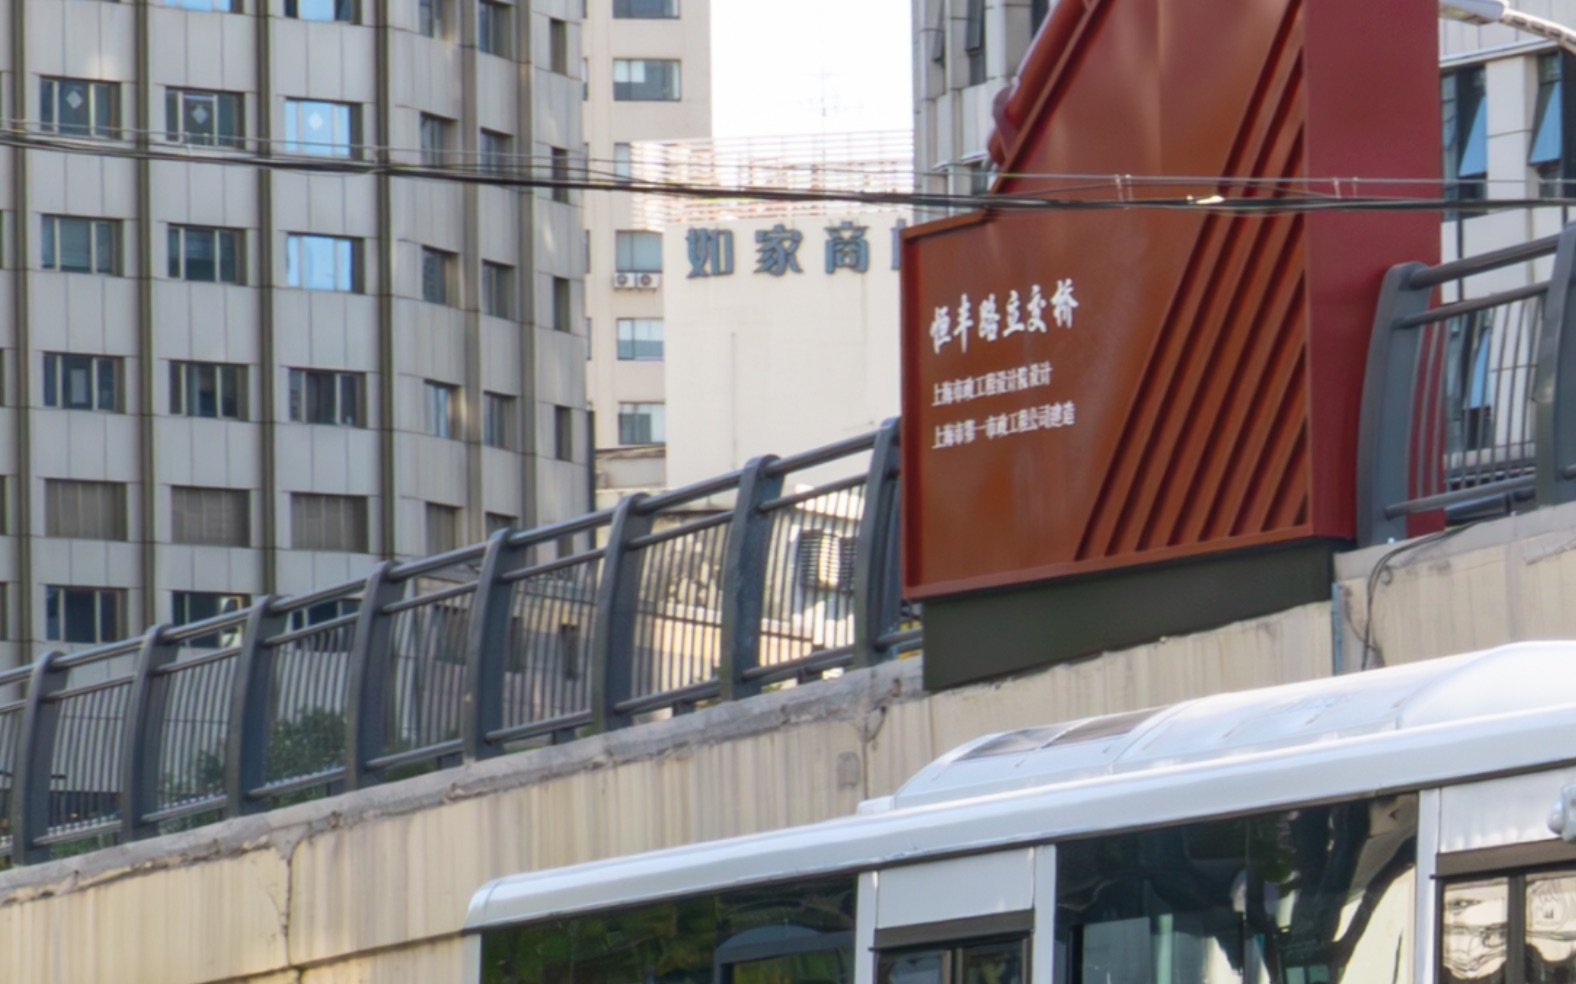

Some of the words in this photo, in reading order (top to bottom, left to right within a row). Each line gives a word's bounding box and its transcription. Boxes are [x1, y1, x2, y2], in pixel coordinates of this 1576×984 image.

[686, 218, 906, 279] 如家商
[930, 278, 1079, 354] 恒丰路立交桥
